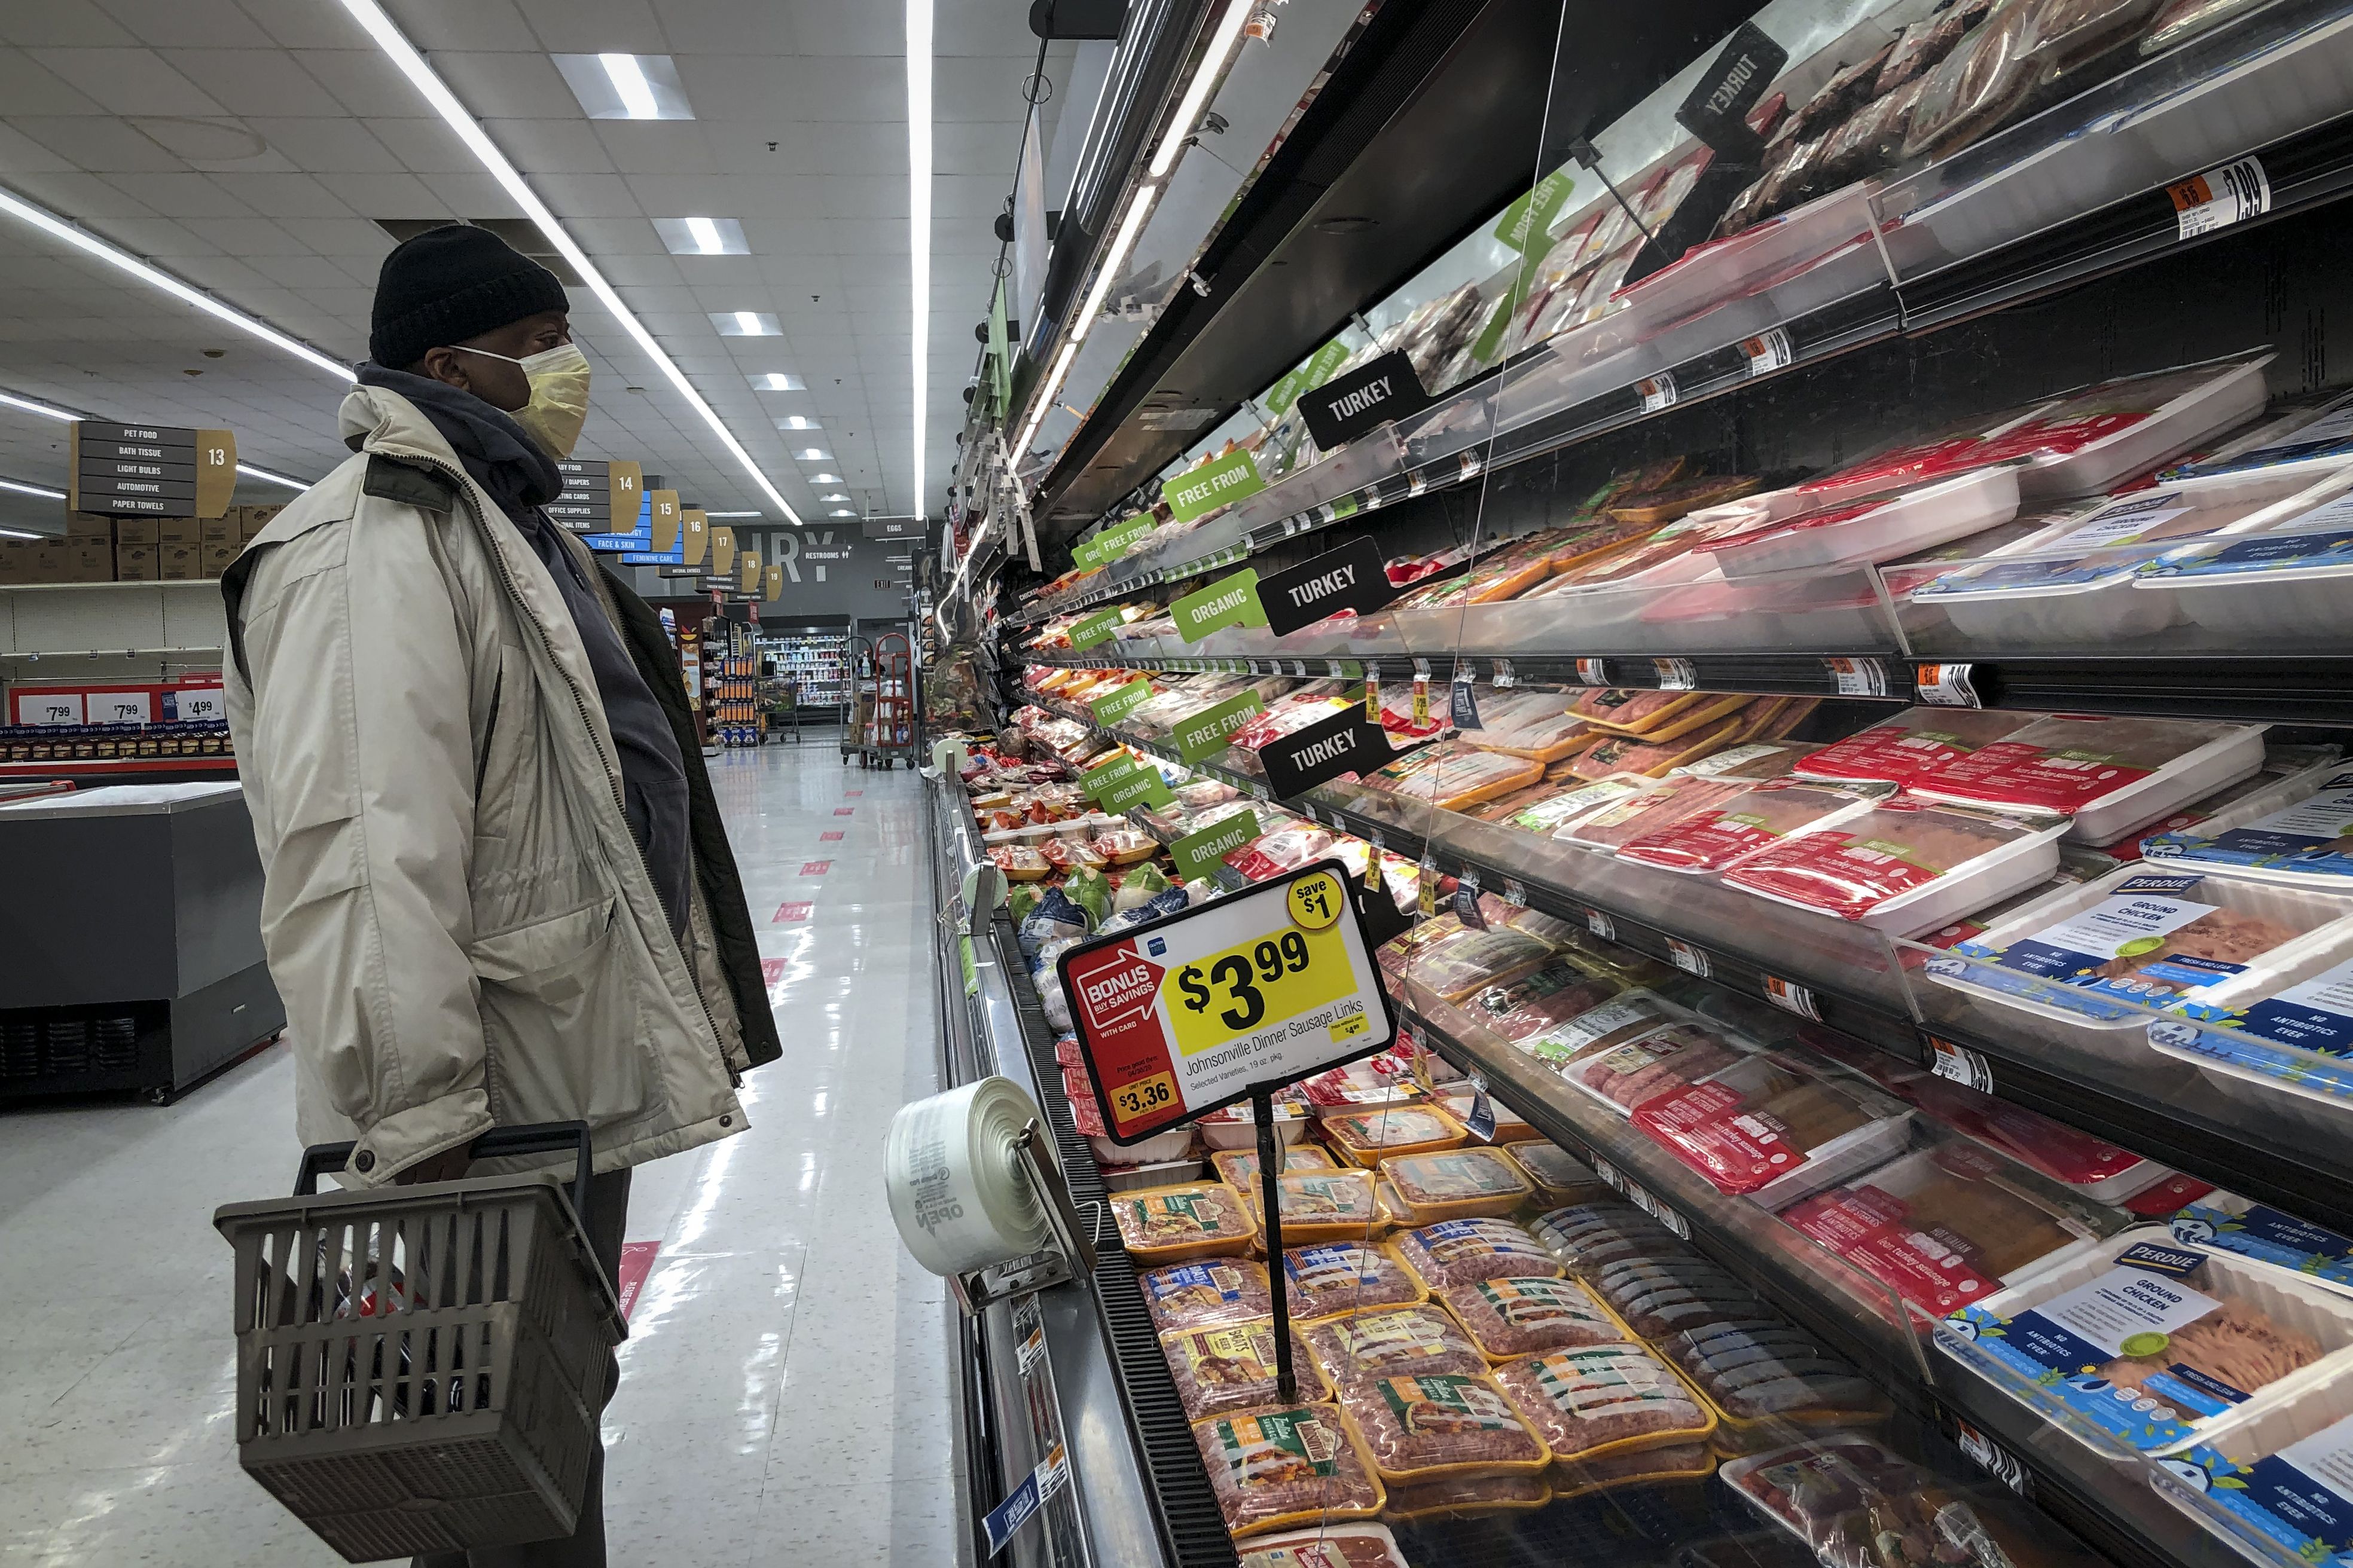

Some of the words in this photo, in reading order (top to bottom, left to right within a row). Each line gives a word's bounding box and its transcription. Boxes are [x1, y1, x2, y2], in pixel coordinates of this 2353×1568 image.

[1327, 376, 1393, 422] TURKEY
[124, 430, 138, 438] PET
[139, 430, 157, 439] FOOD
[119, 447, 136, 456] BATH
[138, 448, 161, 457] TISSUE
[208, 448, 225, 466] 13
[117, 464, 137, 473] LIGHT
[139, 466, 161, 475] BULBS
[117, 482, 160, 493] AUTOMOTIVE
[619, 477, 633, 490] 14
[1176, 481, 1212, 508] FREE
[1211, 464, 1250, 493] FROM
[113, 500, 135, 509] PAPER
[137, 501, 164, 511] TOWELS
[660, 503, 671, 515] 15
[691, 521, 701, 531] 16
[1103, 534, 1127, 552] FREE
[1128, 523, 1153, 542] FROM
[719, 537, 727, 546] 17
[747, 560, 755, 568] 18
[1288, 564, 1357, 607] TURKEY
[1191, 588, 1248, 624] ORGANIC
[1076, 626, 1097, 643] FREE
[1097, 616, 1119, 632] FROM
[1100, 701, 1122, 717] FREE
[1123, 689, 1147, 707] FROM
[1185, 722, 1220, 748] FREE
[1220, 703, 1257, 733] FROM
[1290, 728, 1357, 771] TURKEY
[1087, 777, 1109, 790] FREE
[1109, 763, 1132, 780] FROM
[1113, 778, 1152, 803] ORGANIC
[1191, 829, 1246, 863] ORGANIC
[1296, 880, 1327, 900] save
[2126, 878, 2194, 888] PERDUE
[1304, 894, 1330, 919] $1
[2118, 908, 2165, 921] CHICKEN
[2132, 901, 2178, 914] GROUND
[2022, 953, 2067, 967] ANTIBIOTICS
[1087, 964, 1150, 1004] BONUS
[1094, 1001, 1107, 1012] BUY
[1109, 981, 1155, 1008] SAVINGS
[1100, 1028, 1118, 1038] WITH
[1118, 1021, 1137, 1031] CARD
[1186, 1042, 1252, 1076] Johnsonville
[1252, 1029, 1287, 1051] Dinner
[1289, 1011, 1333, 1037] Sausage
[1334, 1000, 1363, 1019] Links
[2270, 1016, 2338, 1037] ANTIBIOTICS
[1190, 1075, 1219, 1091] Selected
[1219, 1065, 1249, 1081] Varieties,
[1250, 1061, 1258, 1069] 19
[1269, 1052, 1284, 1063] pkg.
[1119, 1082, 1170, 1112] $3.36
[2269, 1222, 2328, 1243] ANTIBIOTICS
[1893, 1248, 1919, 1266] turkey
[1916, 1263, 1951, 1287] sausage
[2129, 1246, 2198, 1267] PERDUE
[2122, 1286, 2170, 1311] CHICKEN
[2137, 1279, 2183, 1303] GROUND
[1229, 1329, 1250, 1352] BRATS
[2027, 1331, 2071, 1357] ANTIBIOTICS
